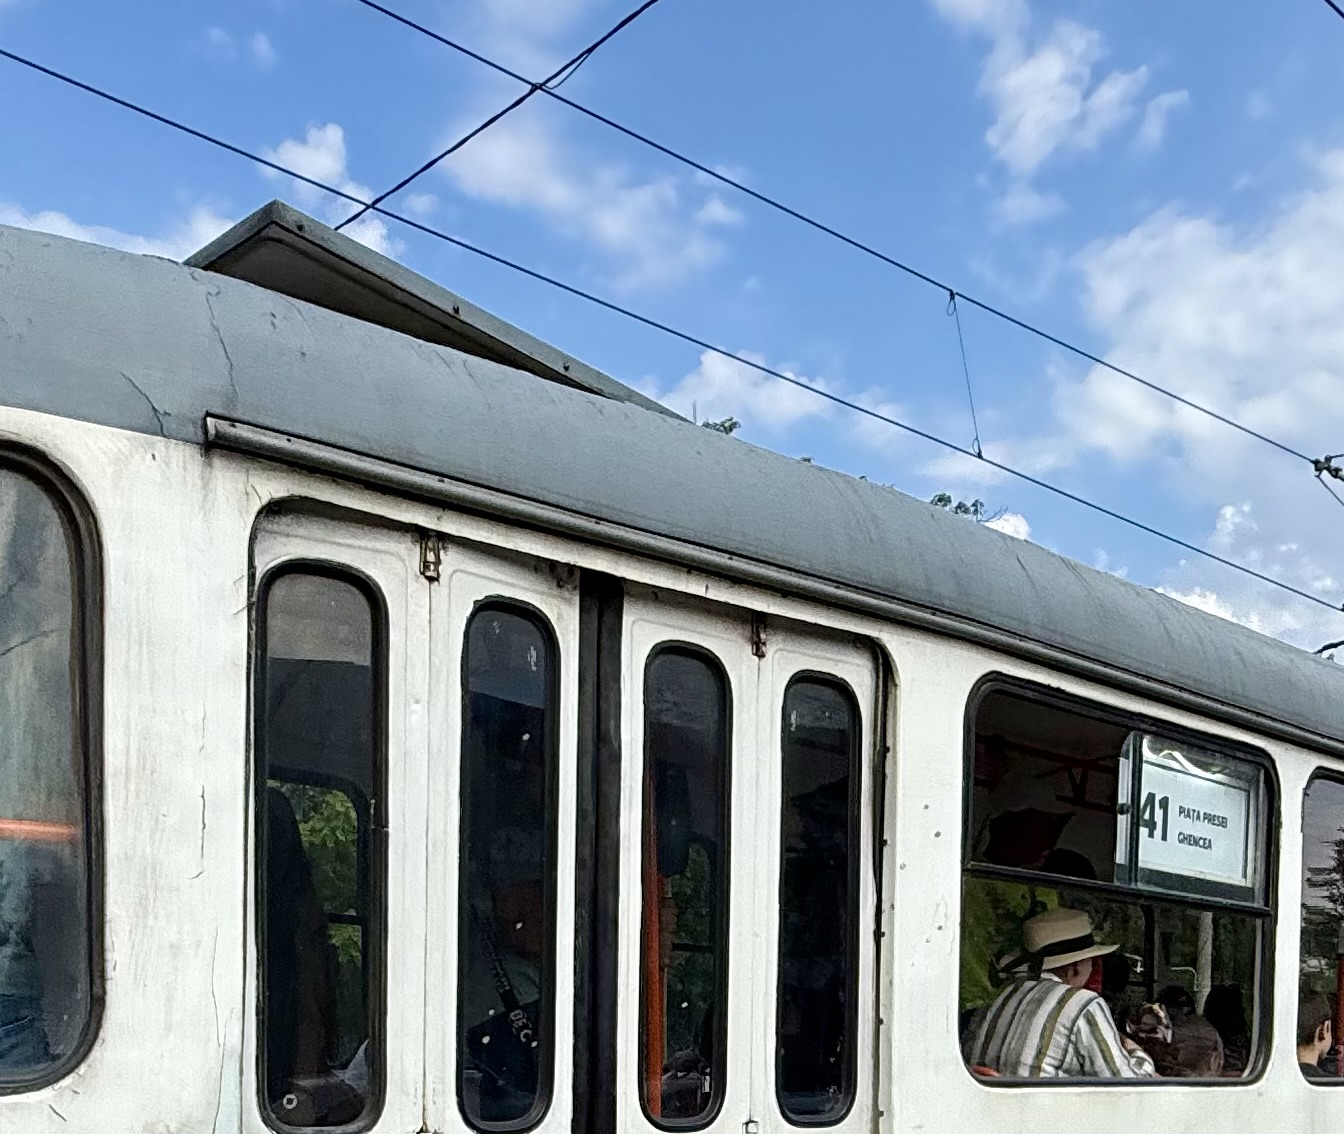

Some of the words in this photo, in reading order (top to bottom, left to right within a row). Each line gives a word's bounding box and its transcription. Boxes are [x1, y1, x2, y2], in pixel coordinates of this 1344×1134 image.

[1139, 791, 1170, 843] 41
[1202, 811, 1229, 829] PRESEI
[1177, 831, 1213, 851] GHENCEA
